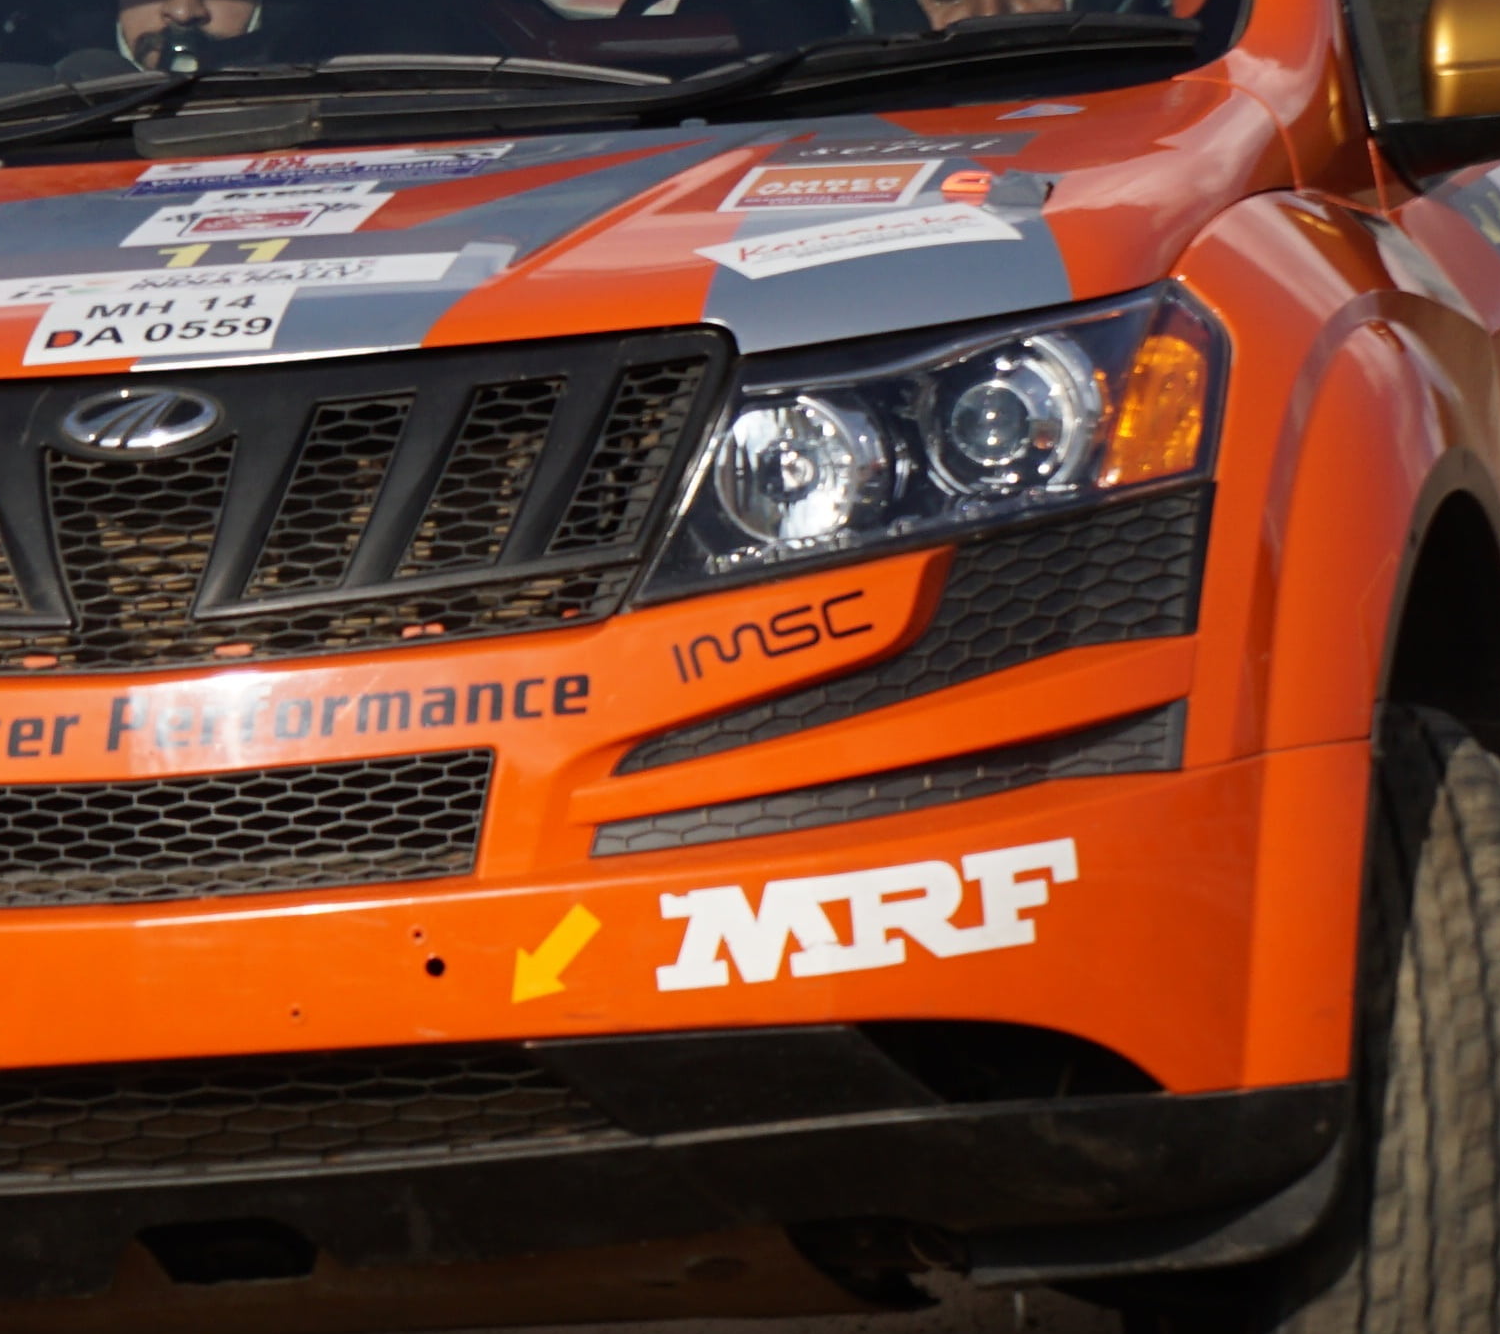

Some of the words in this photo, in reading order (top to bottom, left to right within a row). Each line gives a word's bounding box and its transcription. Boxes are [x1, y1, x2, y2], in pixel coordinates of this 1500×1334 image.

[44, 326, 125, 350] DA
[144, 317, 274, 342] 0559
[85, 299, 173, 320] MH
[199, 295, 258, 312] 14
[106, 672, 590, 754] Performance
[656, 837, 1079, 993] MRF
